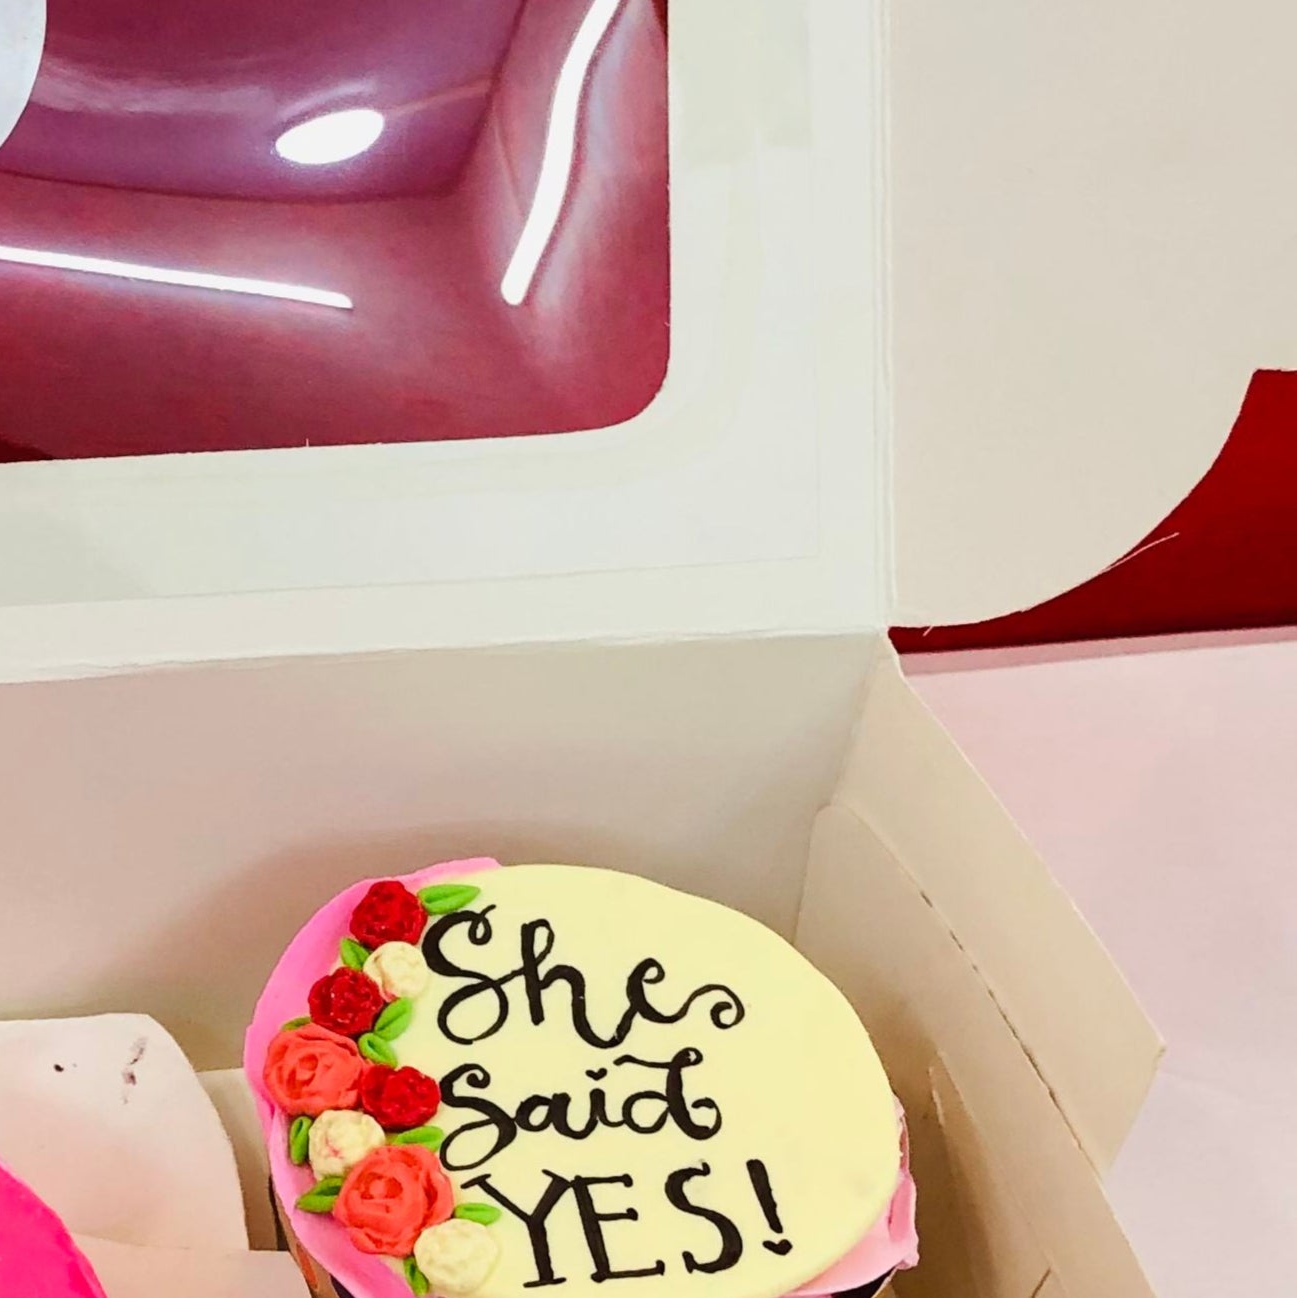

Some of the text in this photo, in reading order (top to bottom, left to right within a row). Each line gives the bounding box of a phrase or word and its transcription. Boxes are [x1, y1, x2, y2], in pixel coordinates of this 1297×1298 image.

[421, 904, 745, 1049] She
[439, 1047, 722, 1171] Said
[460, 1159, 793, 1288] YES!
